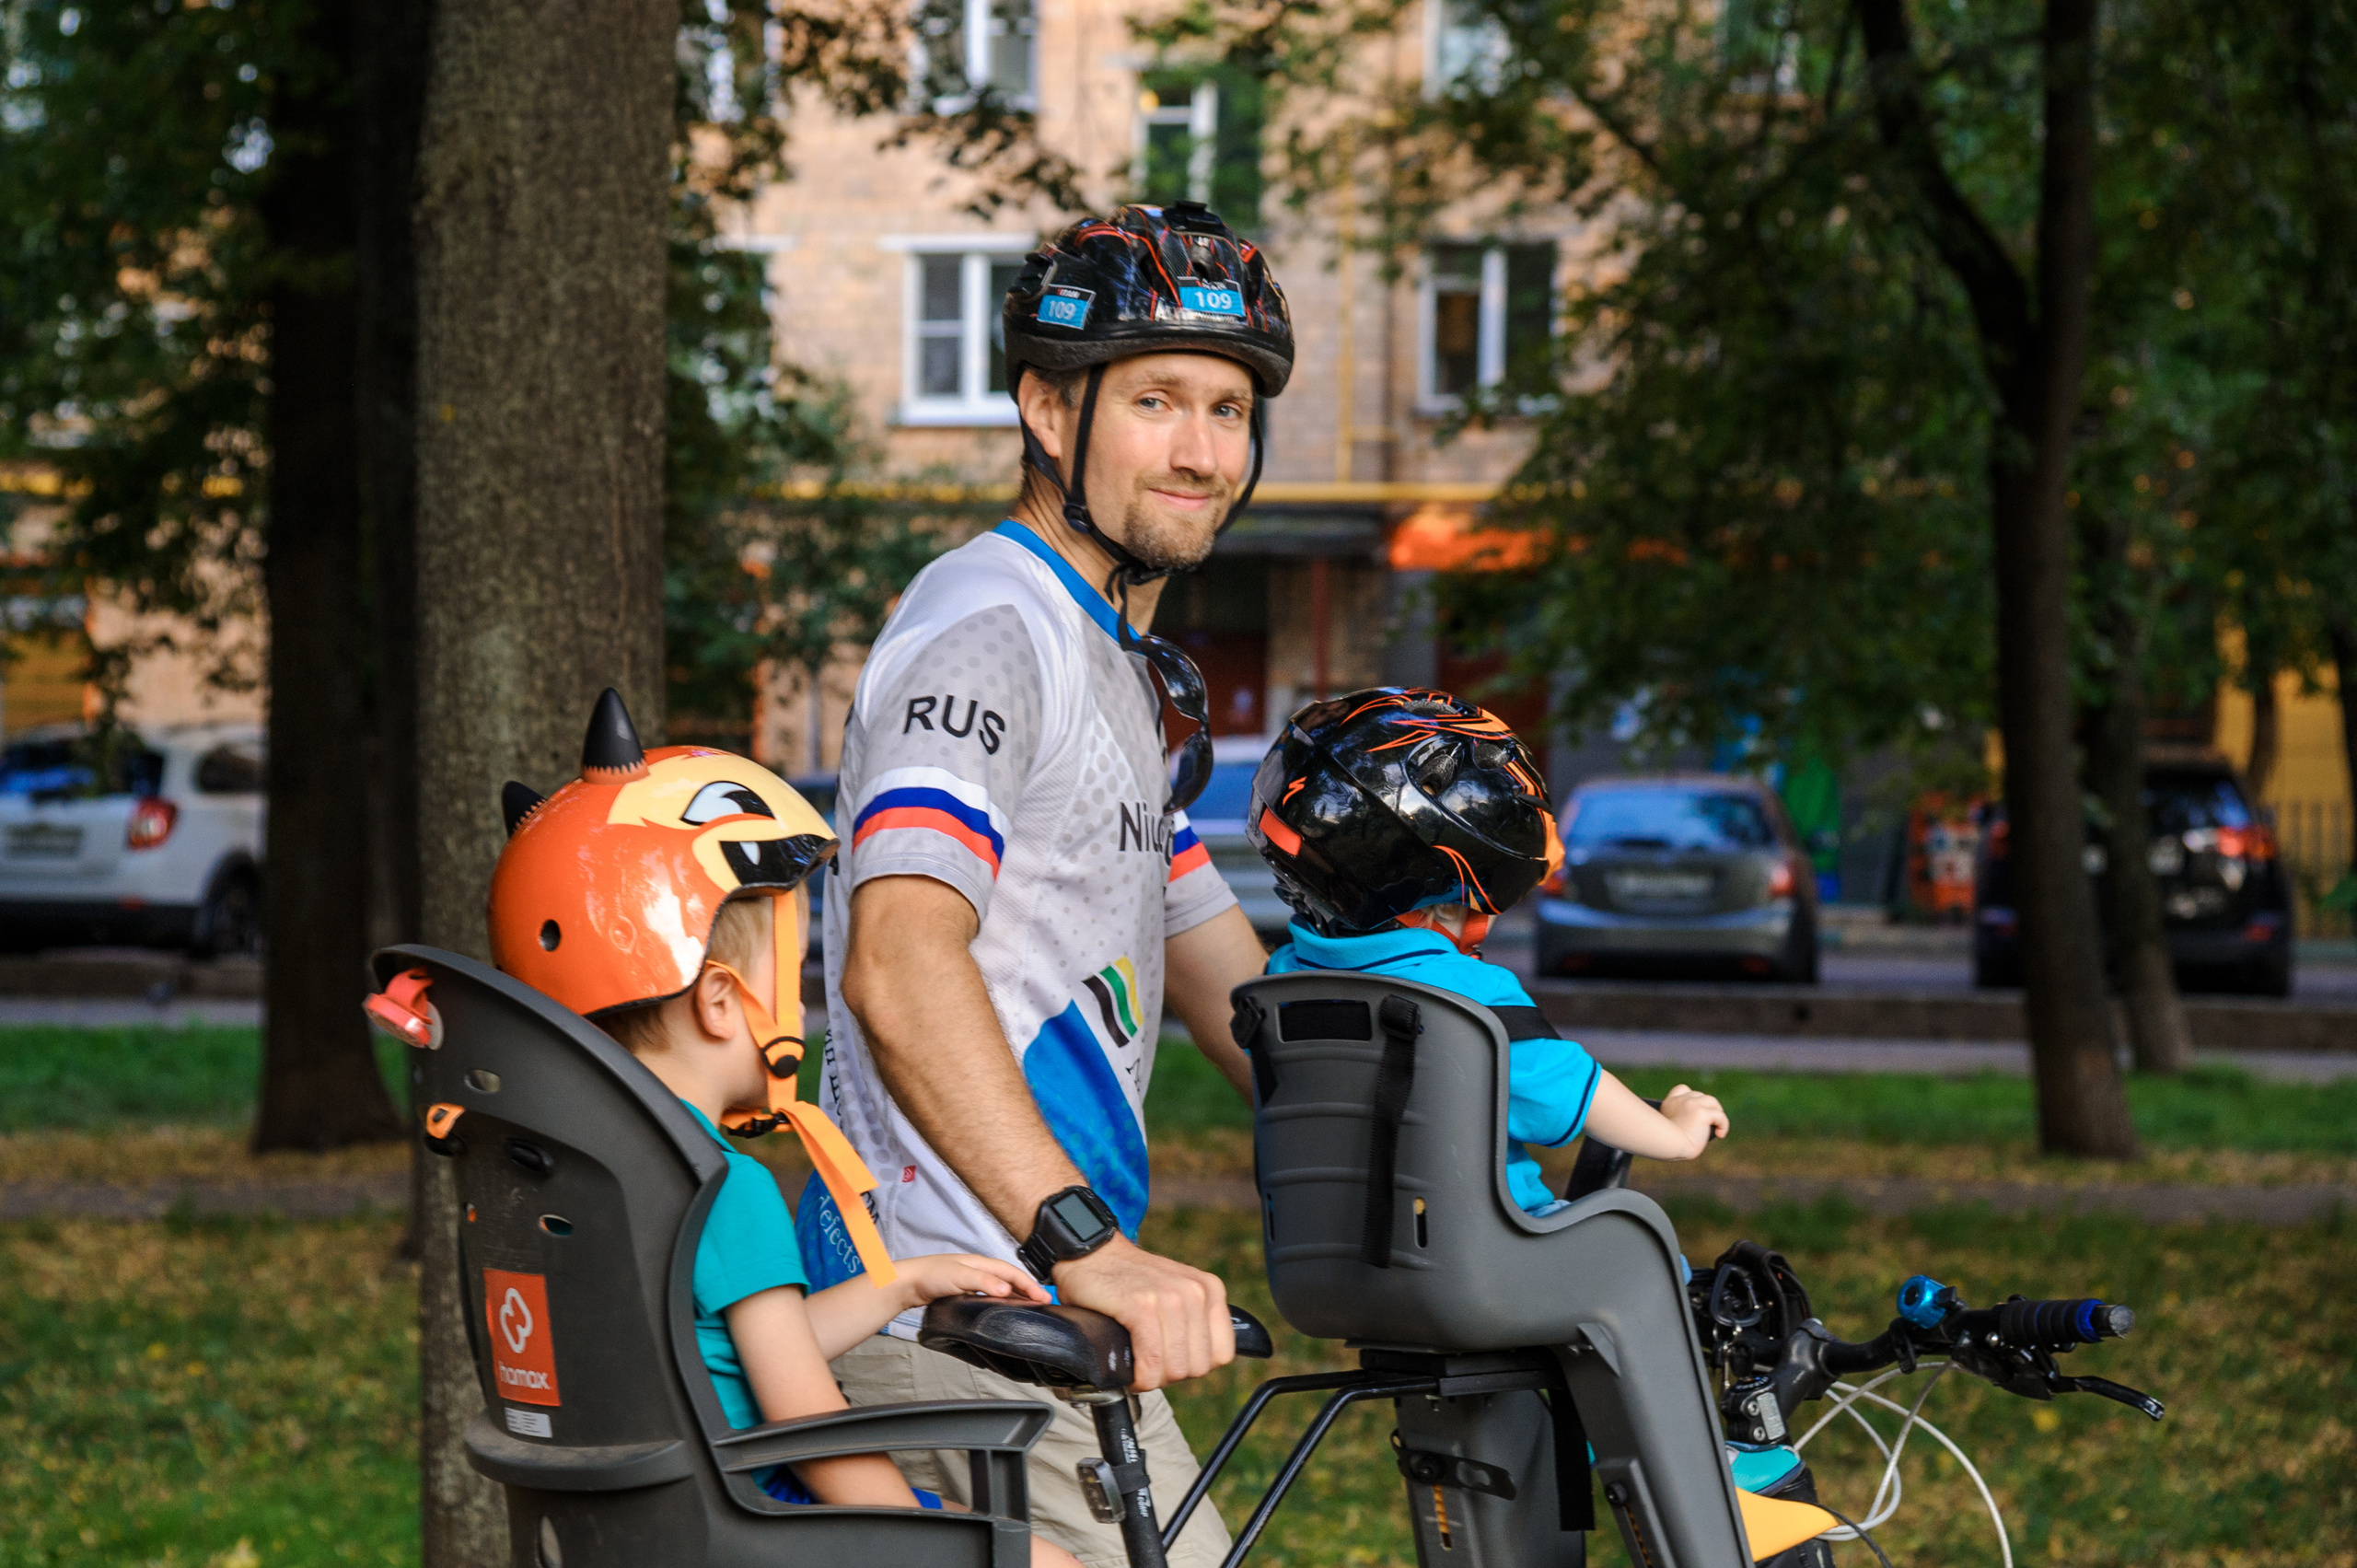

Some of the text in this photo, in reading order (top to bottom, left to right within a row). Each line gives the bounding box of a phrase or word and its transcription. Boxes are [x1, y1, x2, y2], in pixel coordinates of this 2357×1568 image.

[1049, 300, 1077, 320] 109
[1195, 291, 1233, 309] 109
[902, 694, 1005, 755] RUS
